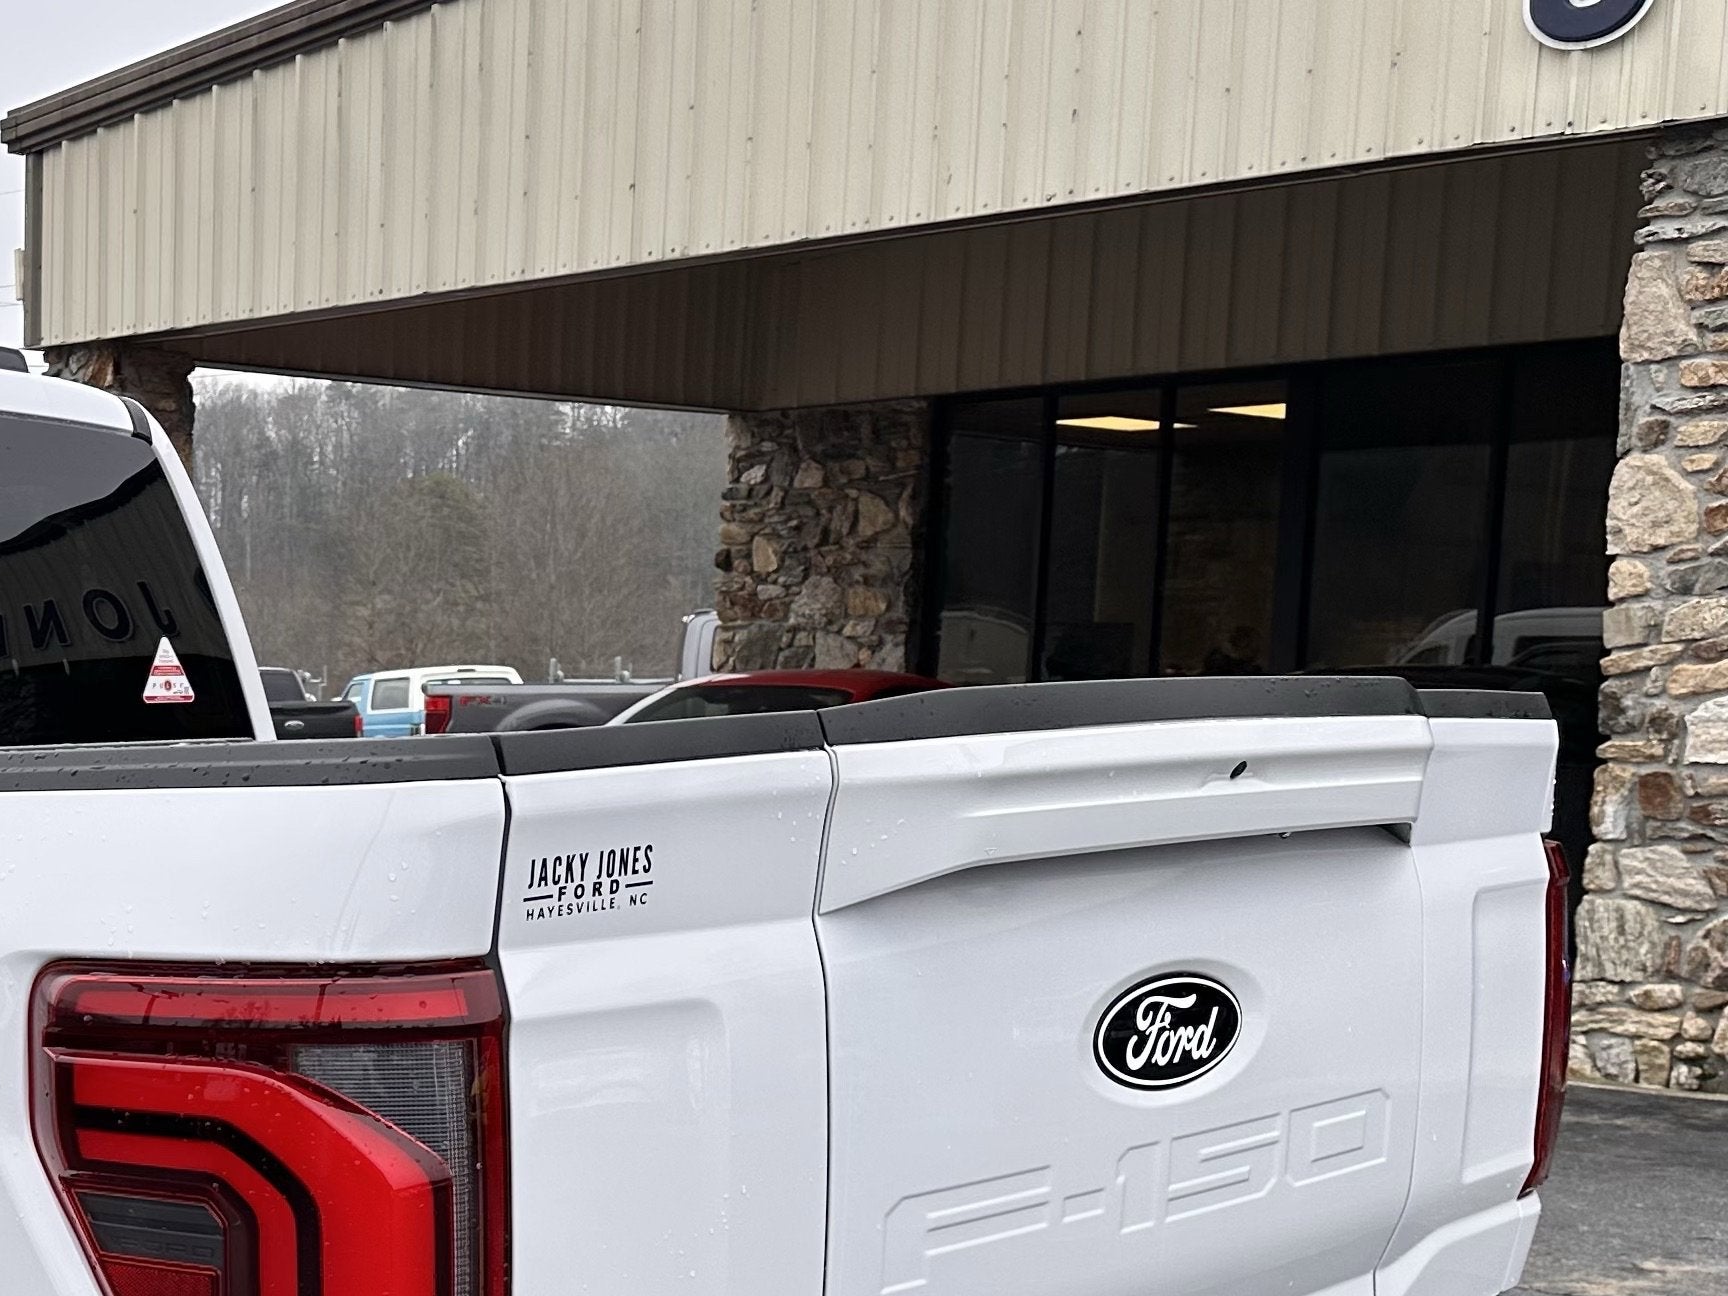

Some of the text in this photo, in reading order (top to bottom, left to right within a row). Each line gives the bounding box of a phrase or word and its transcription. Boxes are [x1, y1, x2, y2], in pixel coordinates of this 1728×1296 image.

[528, 844, 654, 890] JACKY JONES
[557, 878, 620, 902] FORD
[628, 892, 648, 907] NC
[1125, 993, 1220, 1071] Ford
[880, 1087, 1392, 1296] F-150
